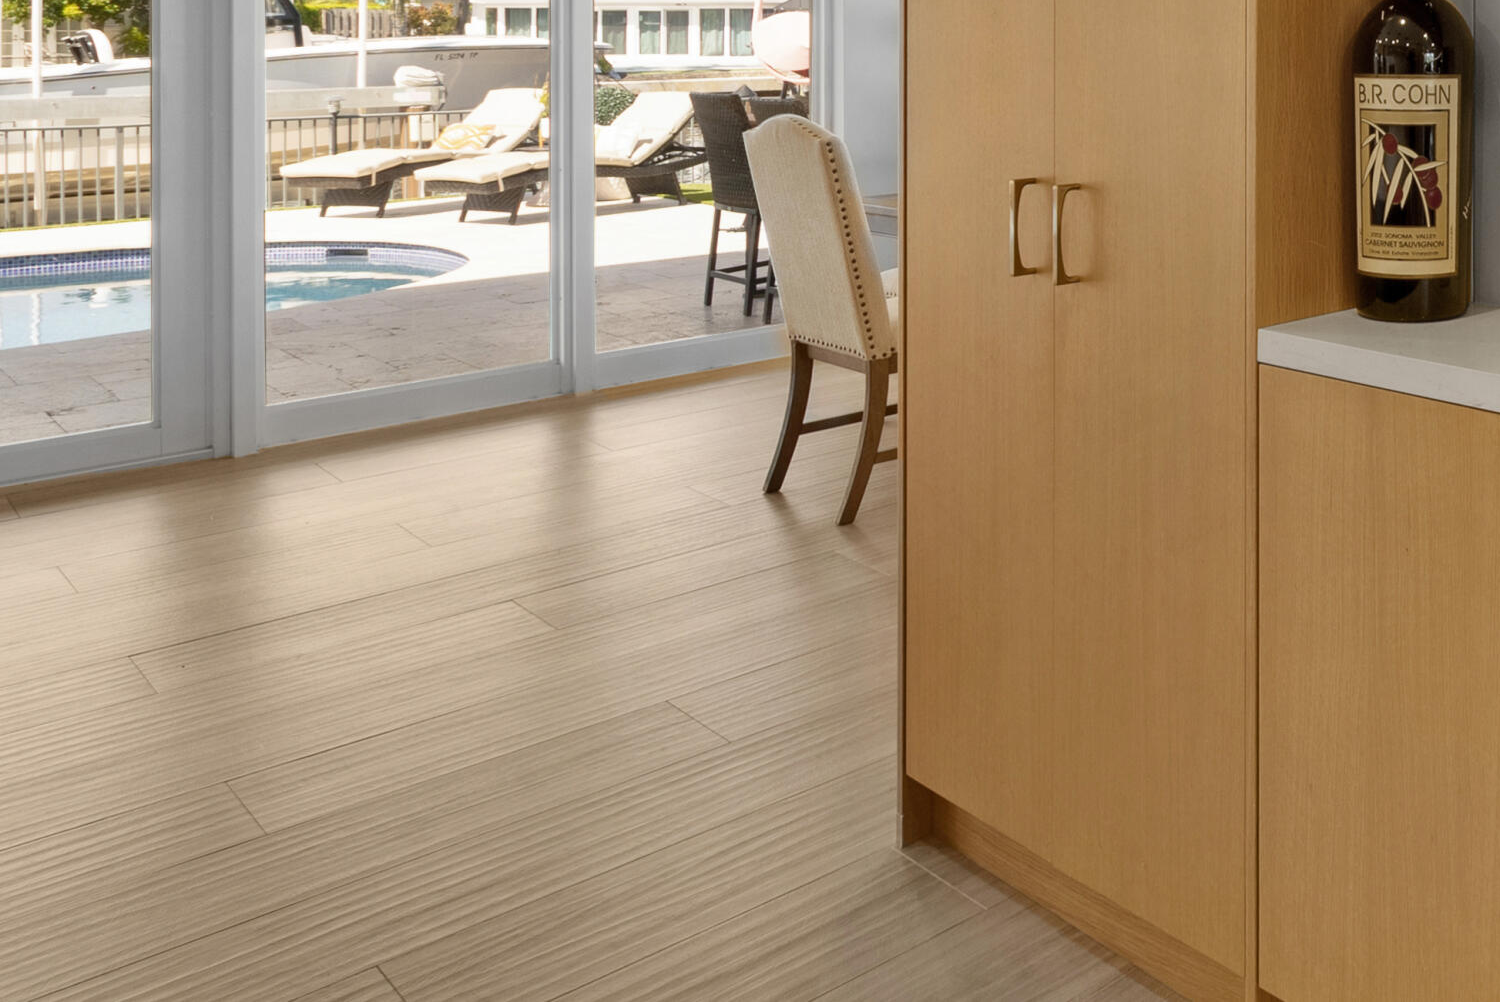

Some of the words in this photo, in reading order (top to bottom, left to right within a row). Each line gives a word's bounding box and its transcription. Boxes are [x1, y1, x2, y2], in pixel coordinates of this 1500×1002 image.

[1358, 83, 1388, 105] B.R.
[1392, 83, 1452, 105] COHN
[1365, 238, 1398, 248] CABERNET
[1399, 240, 1445, 248] SAUVIGNON
